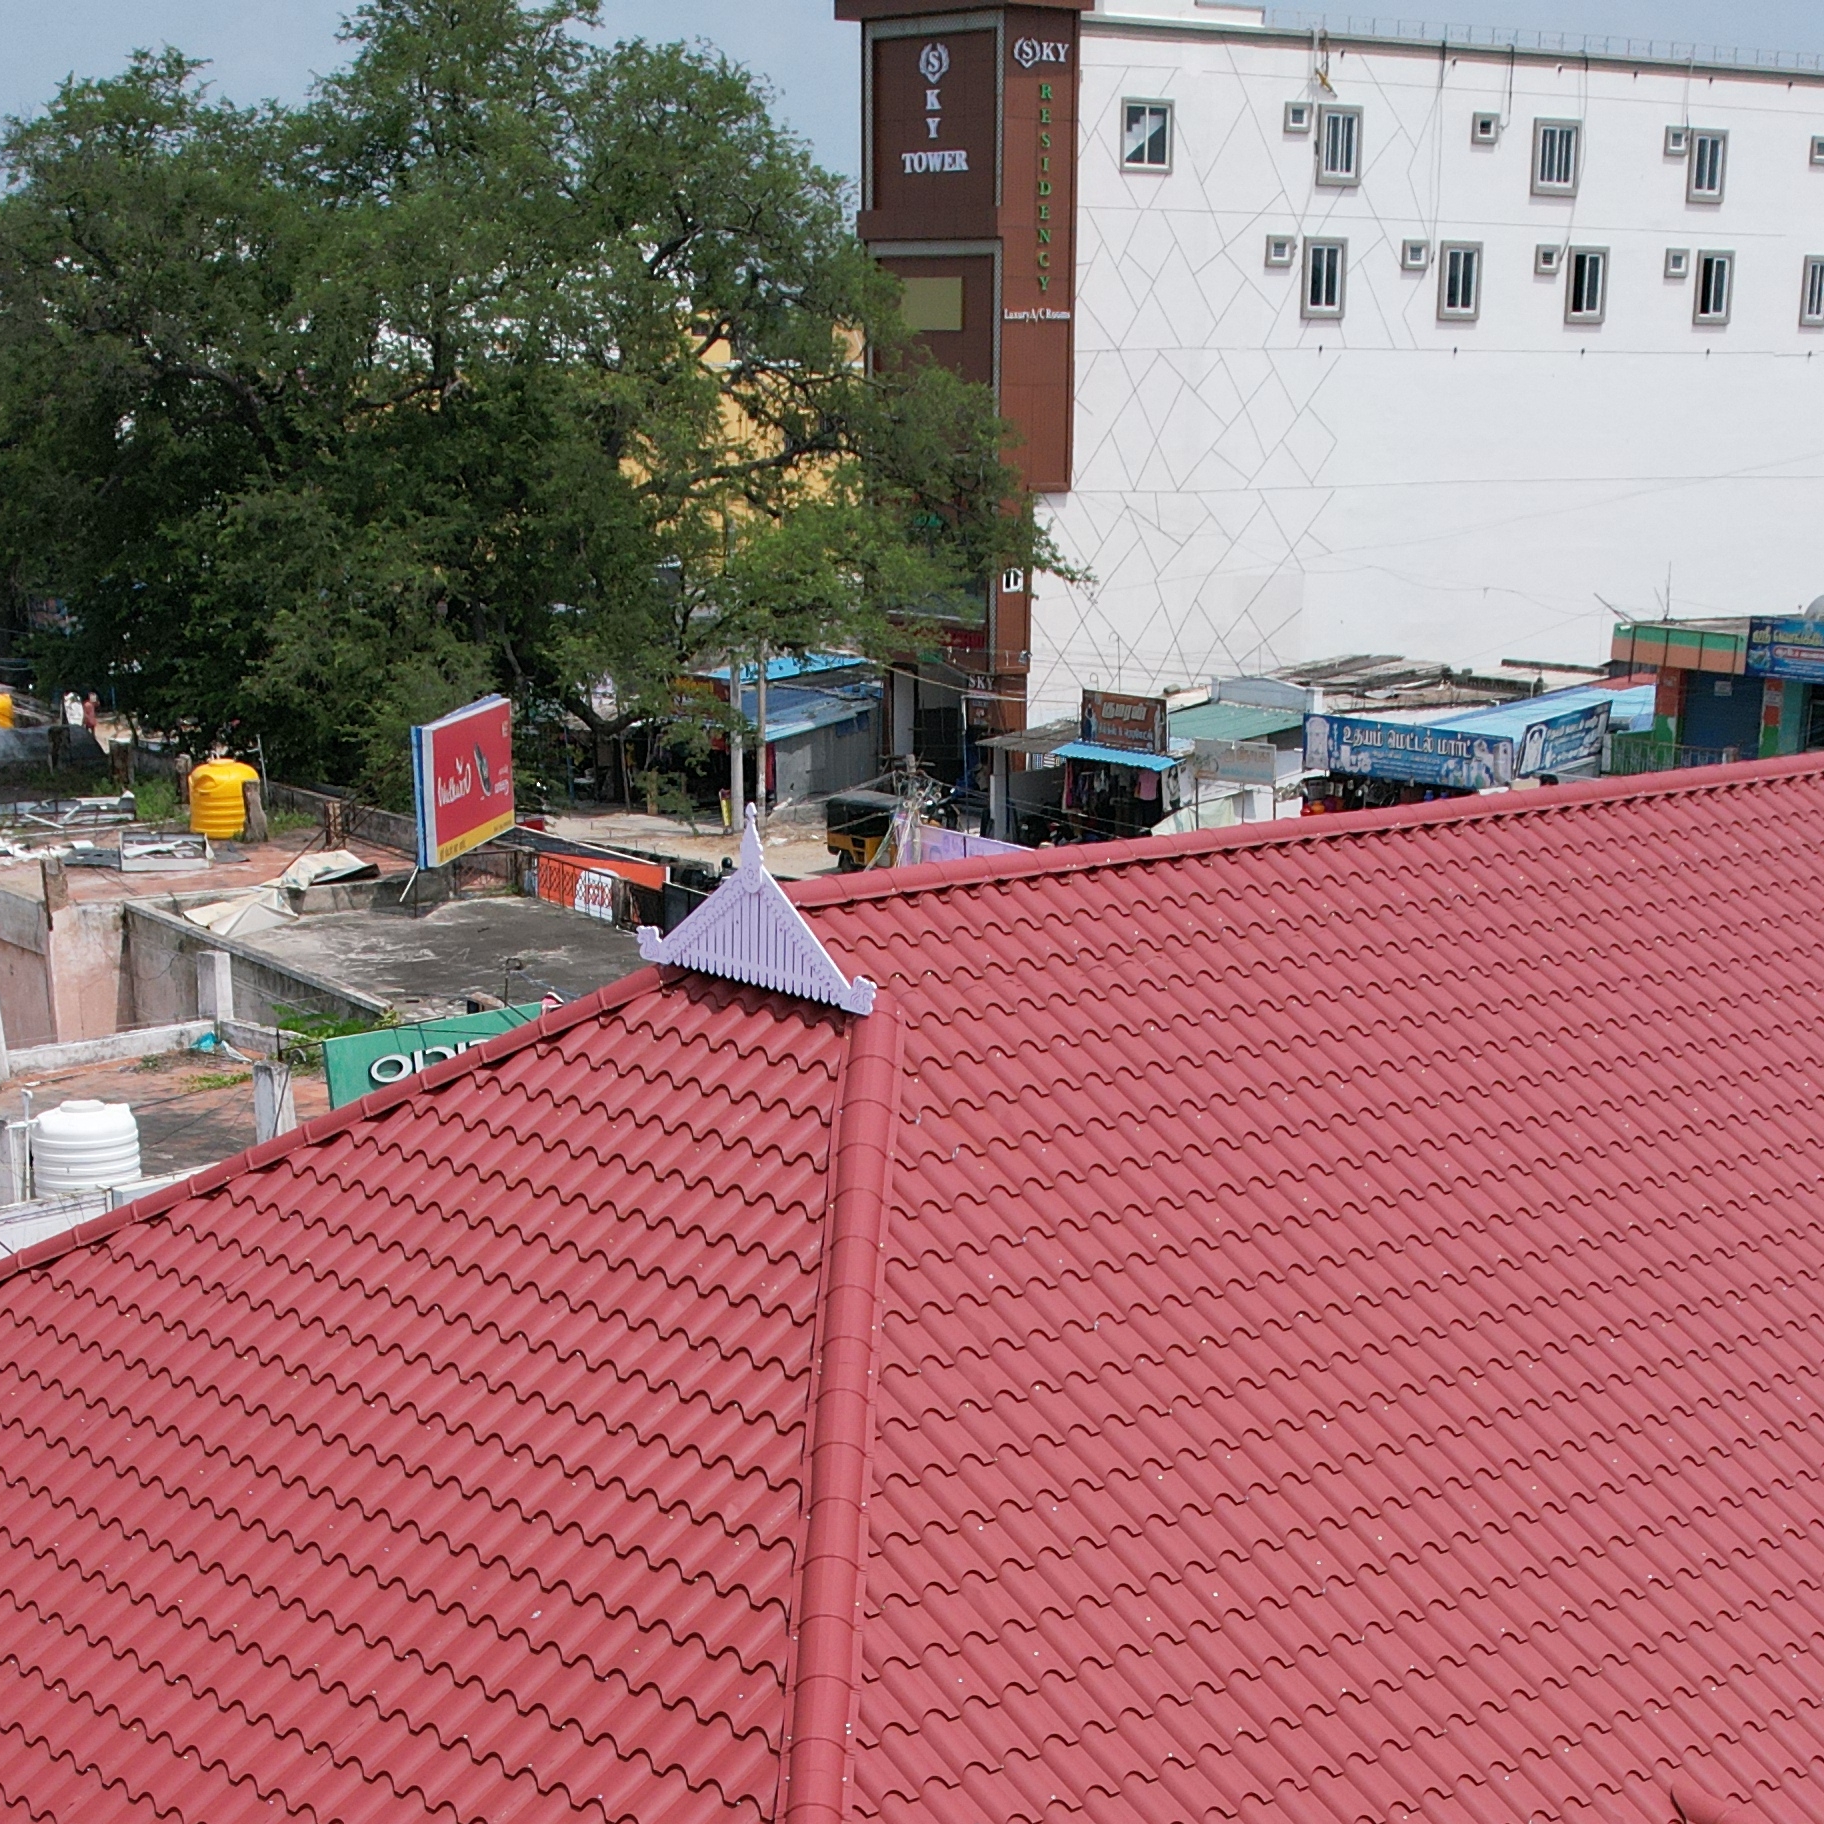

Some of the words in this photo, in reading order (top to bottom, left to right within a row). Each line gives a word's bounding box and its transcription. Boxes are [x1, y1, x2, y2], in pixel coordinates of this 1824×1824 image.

[901, 150, 969, 174] TOWER
[1037, 83, 1052, 292] RESIDENCY
[968, 675, 995, 691] SKY
[1342, 725, 1385, 748] உதயம்
[1388, 728, 1434, 753] மெட்டல்
[1437, 733, 1472, 758] மார்ட்
[370, 1038, 490, 1083] op
